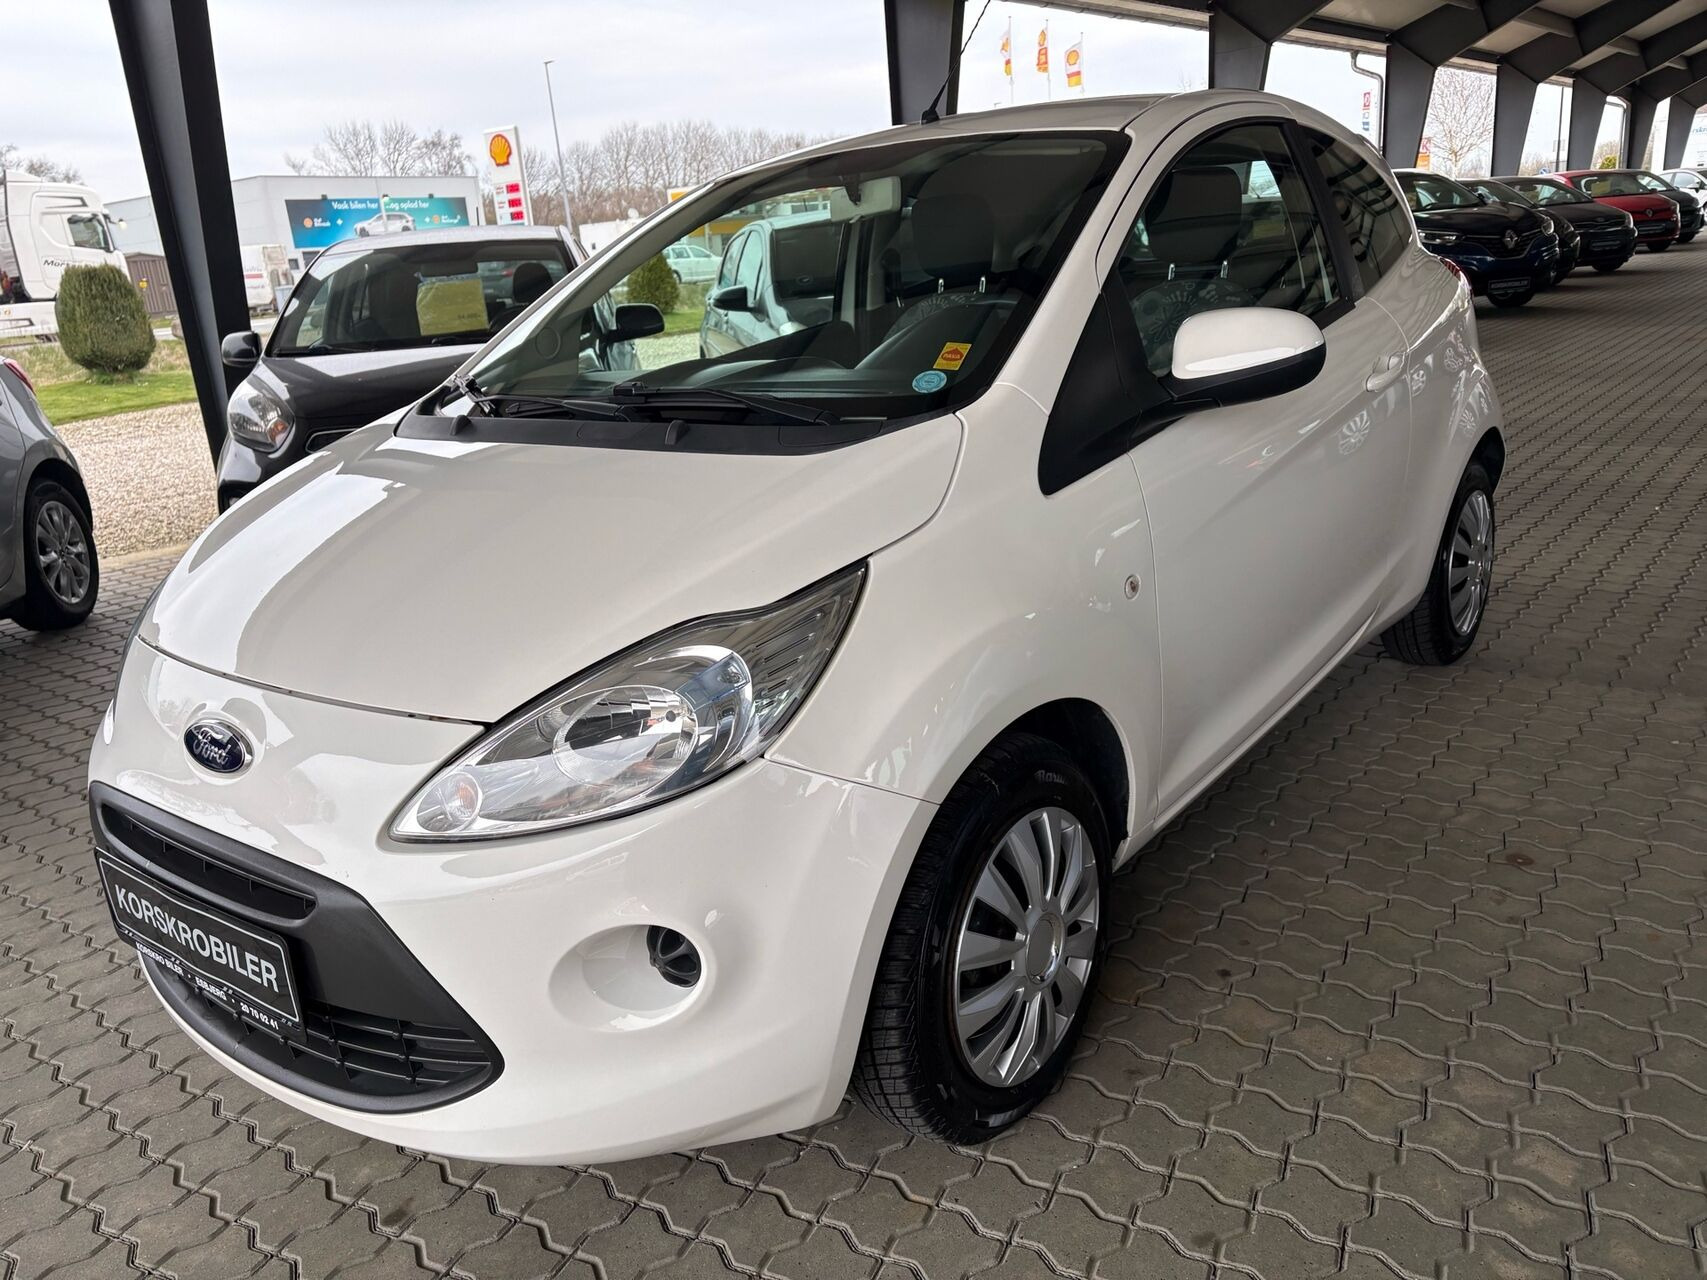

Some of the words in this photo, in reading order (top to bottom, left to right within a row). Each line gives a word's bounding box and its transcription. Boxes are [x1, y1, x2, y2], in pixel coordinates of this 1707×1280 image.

[332, 200, 349, 210] Vask
[350, 200, 367, 209] bilen
[367, 200, 378, 209] her
[192, 727, 232, 765] Ford
[114, 884, 279, 993] KORSKROBILER
[164, 958, 184, 977] BILER
[195, 976, 228, 1001] ESBJERG
[270, 1019, 279, 1031] 41
